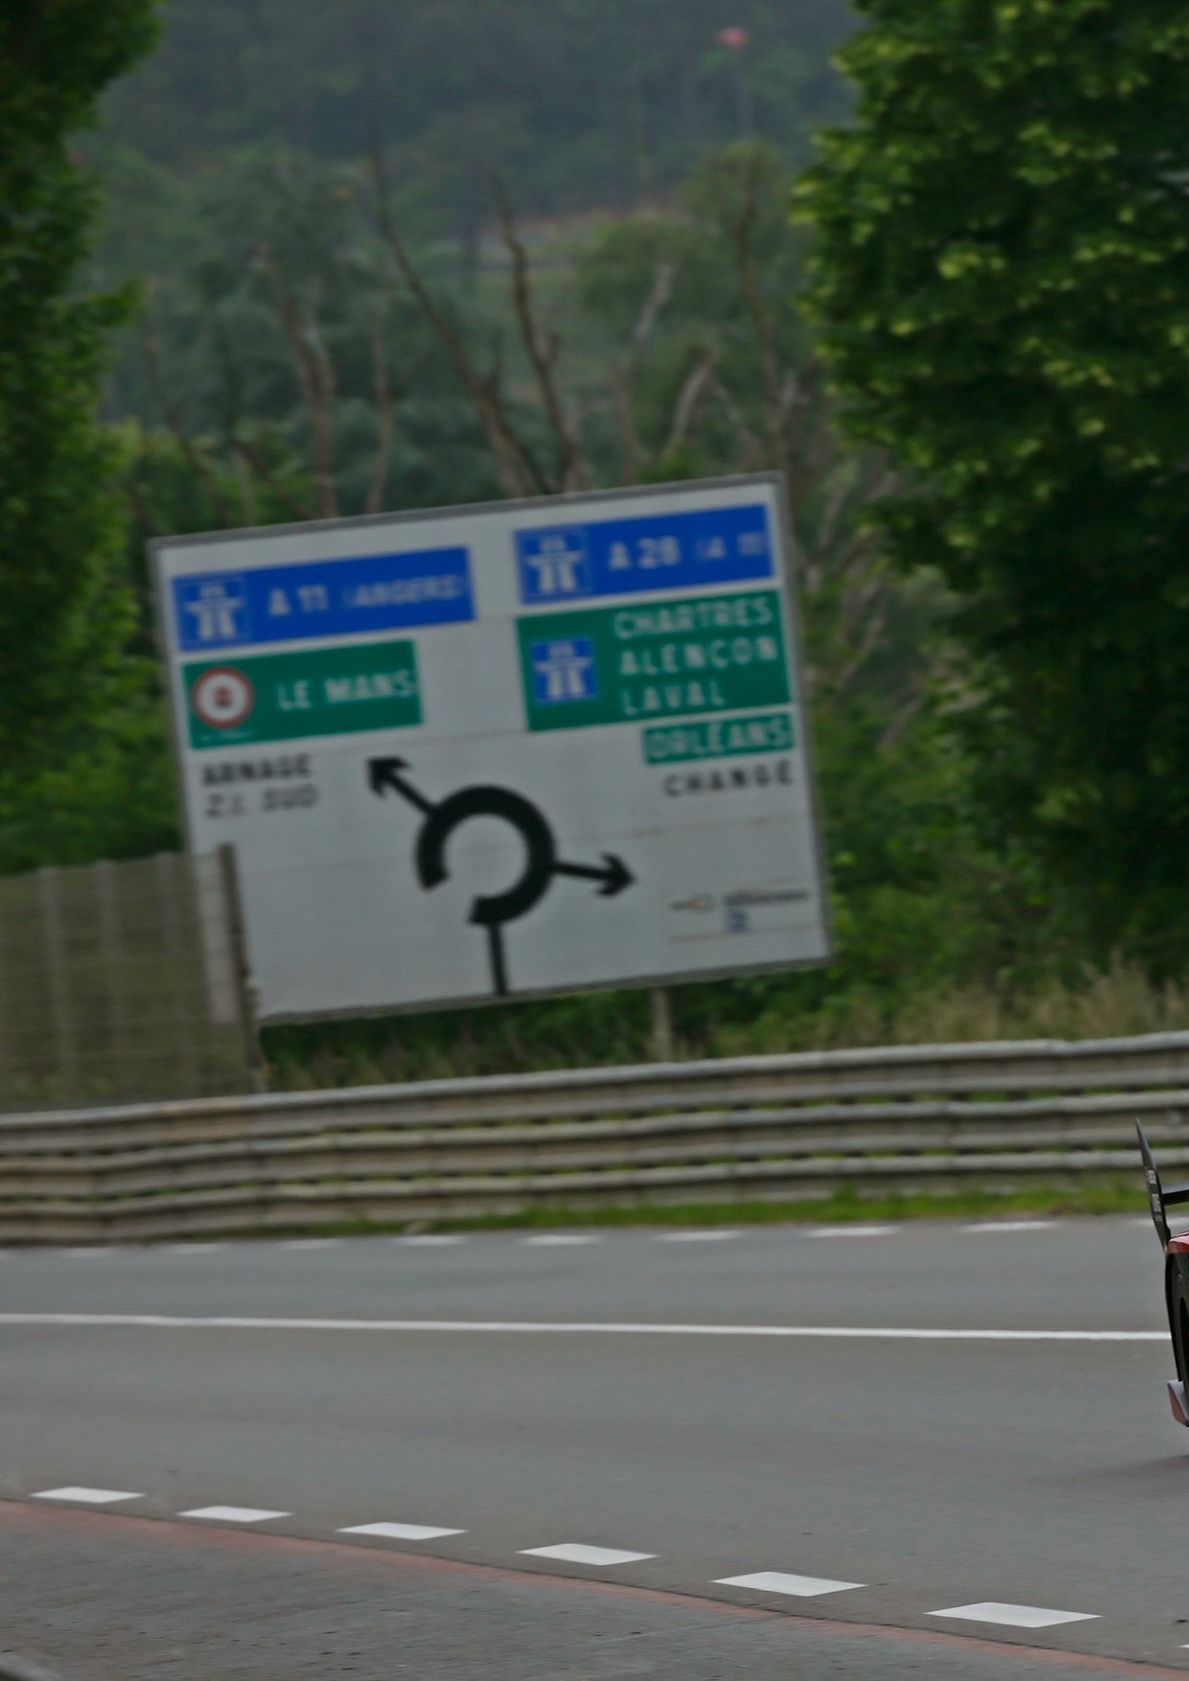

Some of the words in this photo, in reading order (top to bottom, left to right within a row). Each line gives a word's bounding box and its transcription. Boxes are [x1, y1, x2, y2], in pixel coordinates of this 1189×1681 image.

[609, 540, 631, 571] A
[637, 534, 682, 571] 28
[268, 587, 291, 616] A
[615, 595, 774, 640] CHARTRES
[278, 681, 312, 711] LE
[325, 669, 415, 704] MANS
[622, 680, 725, 716] LAVAL
[203, 752, 312, 785] ARNAGE
[264, 783, 319, 813] SUD
